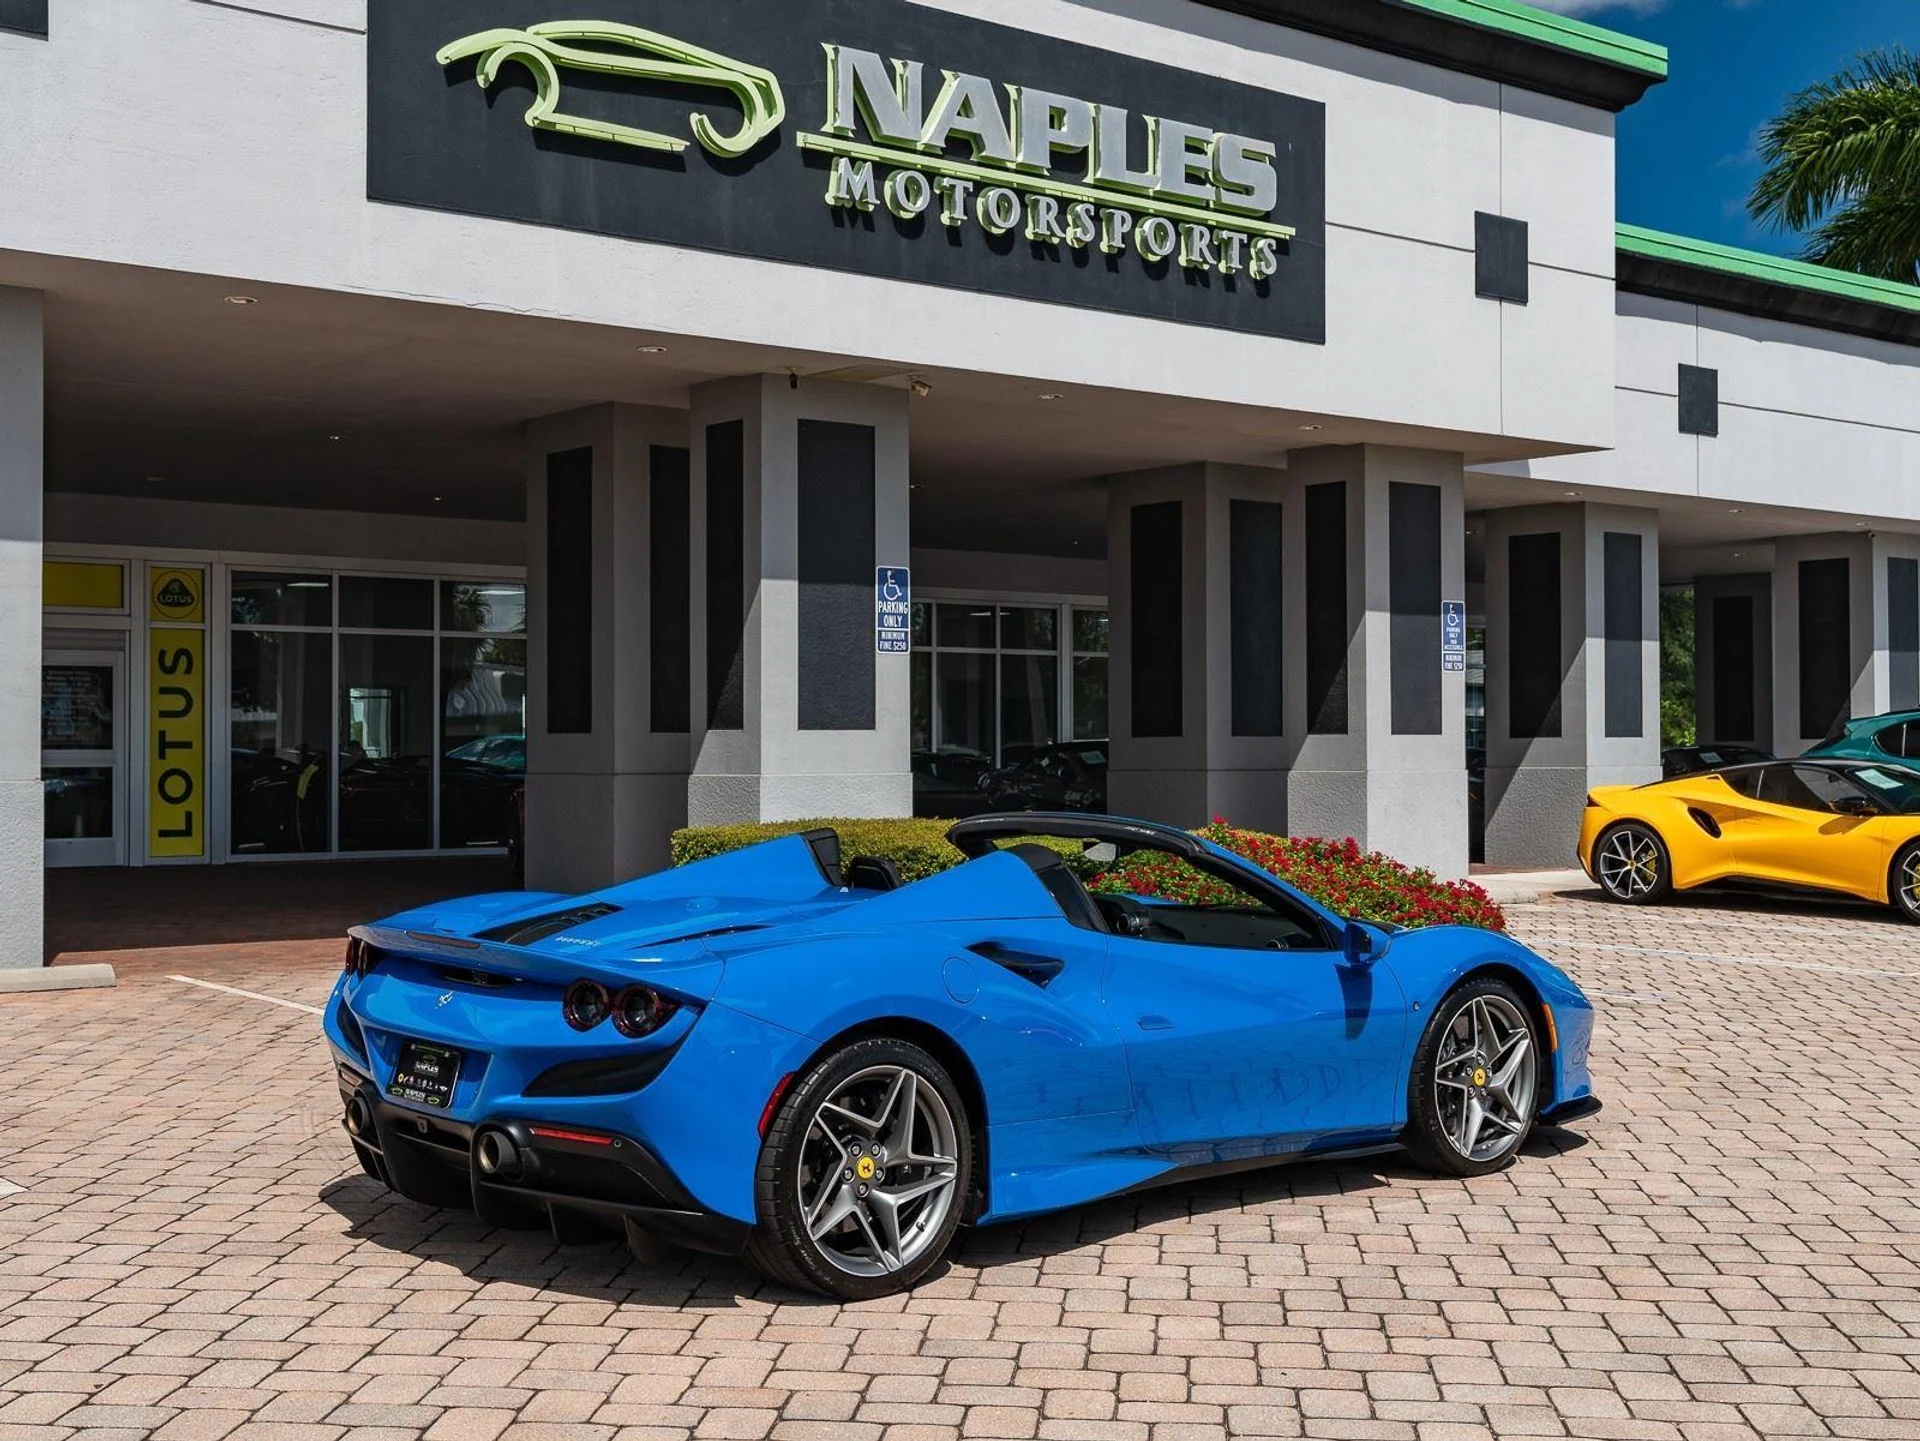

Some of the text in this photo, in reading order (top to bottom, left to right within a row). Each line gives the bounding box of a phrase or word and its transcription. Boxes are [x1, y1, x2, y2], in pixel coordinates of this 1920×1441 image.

[820, 42, 1278, 217] NAPLES
[825, 156, 1278, 280] MOTORSPORTS
[158, 594, 194, 605] LOTUS
[878, 601, 908, 615] PARKING
[883, 614, 903, 628] ONLY
[158, 647, 194, 838] LOTUS
